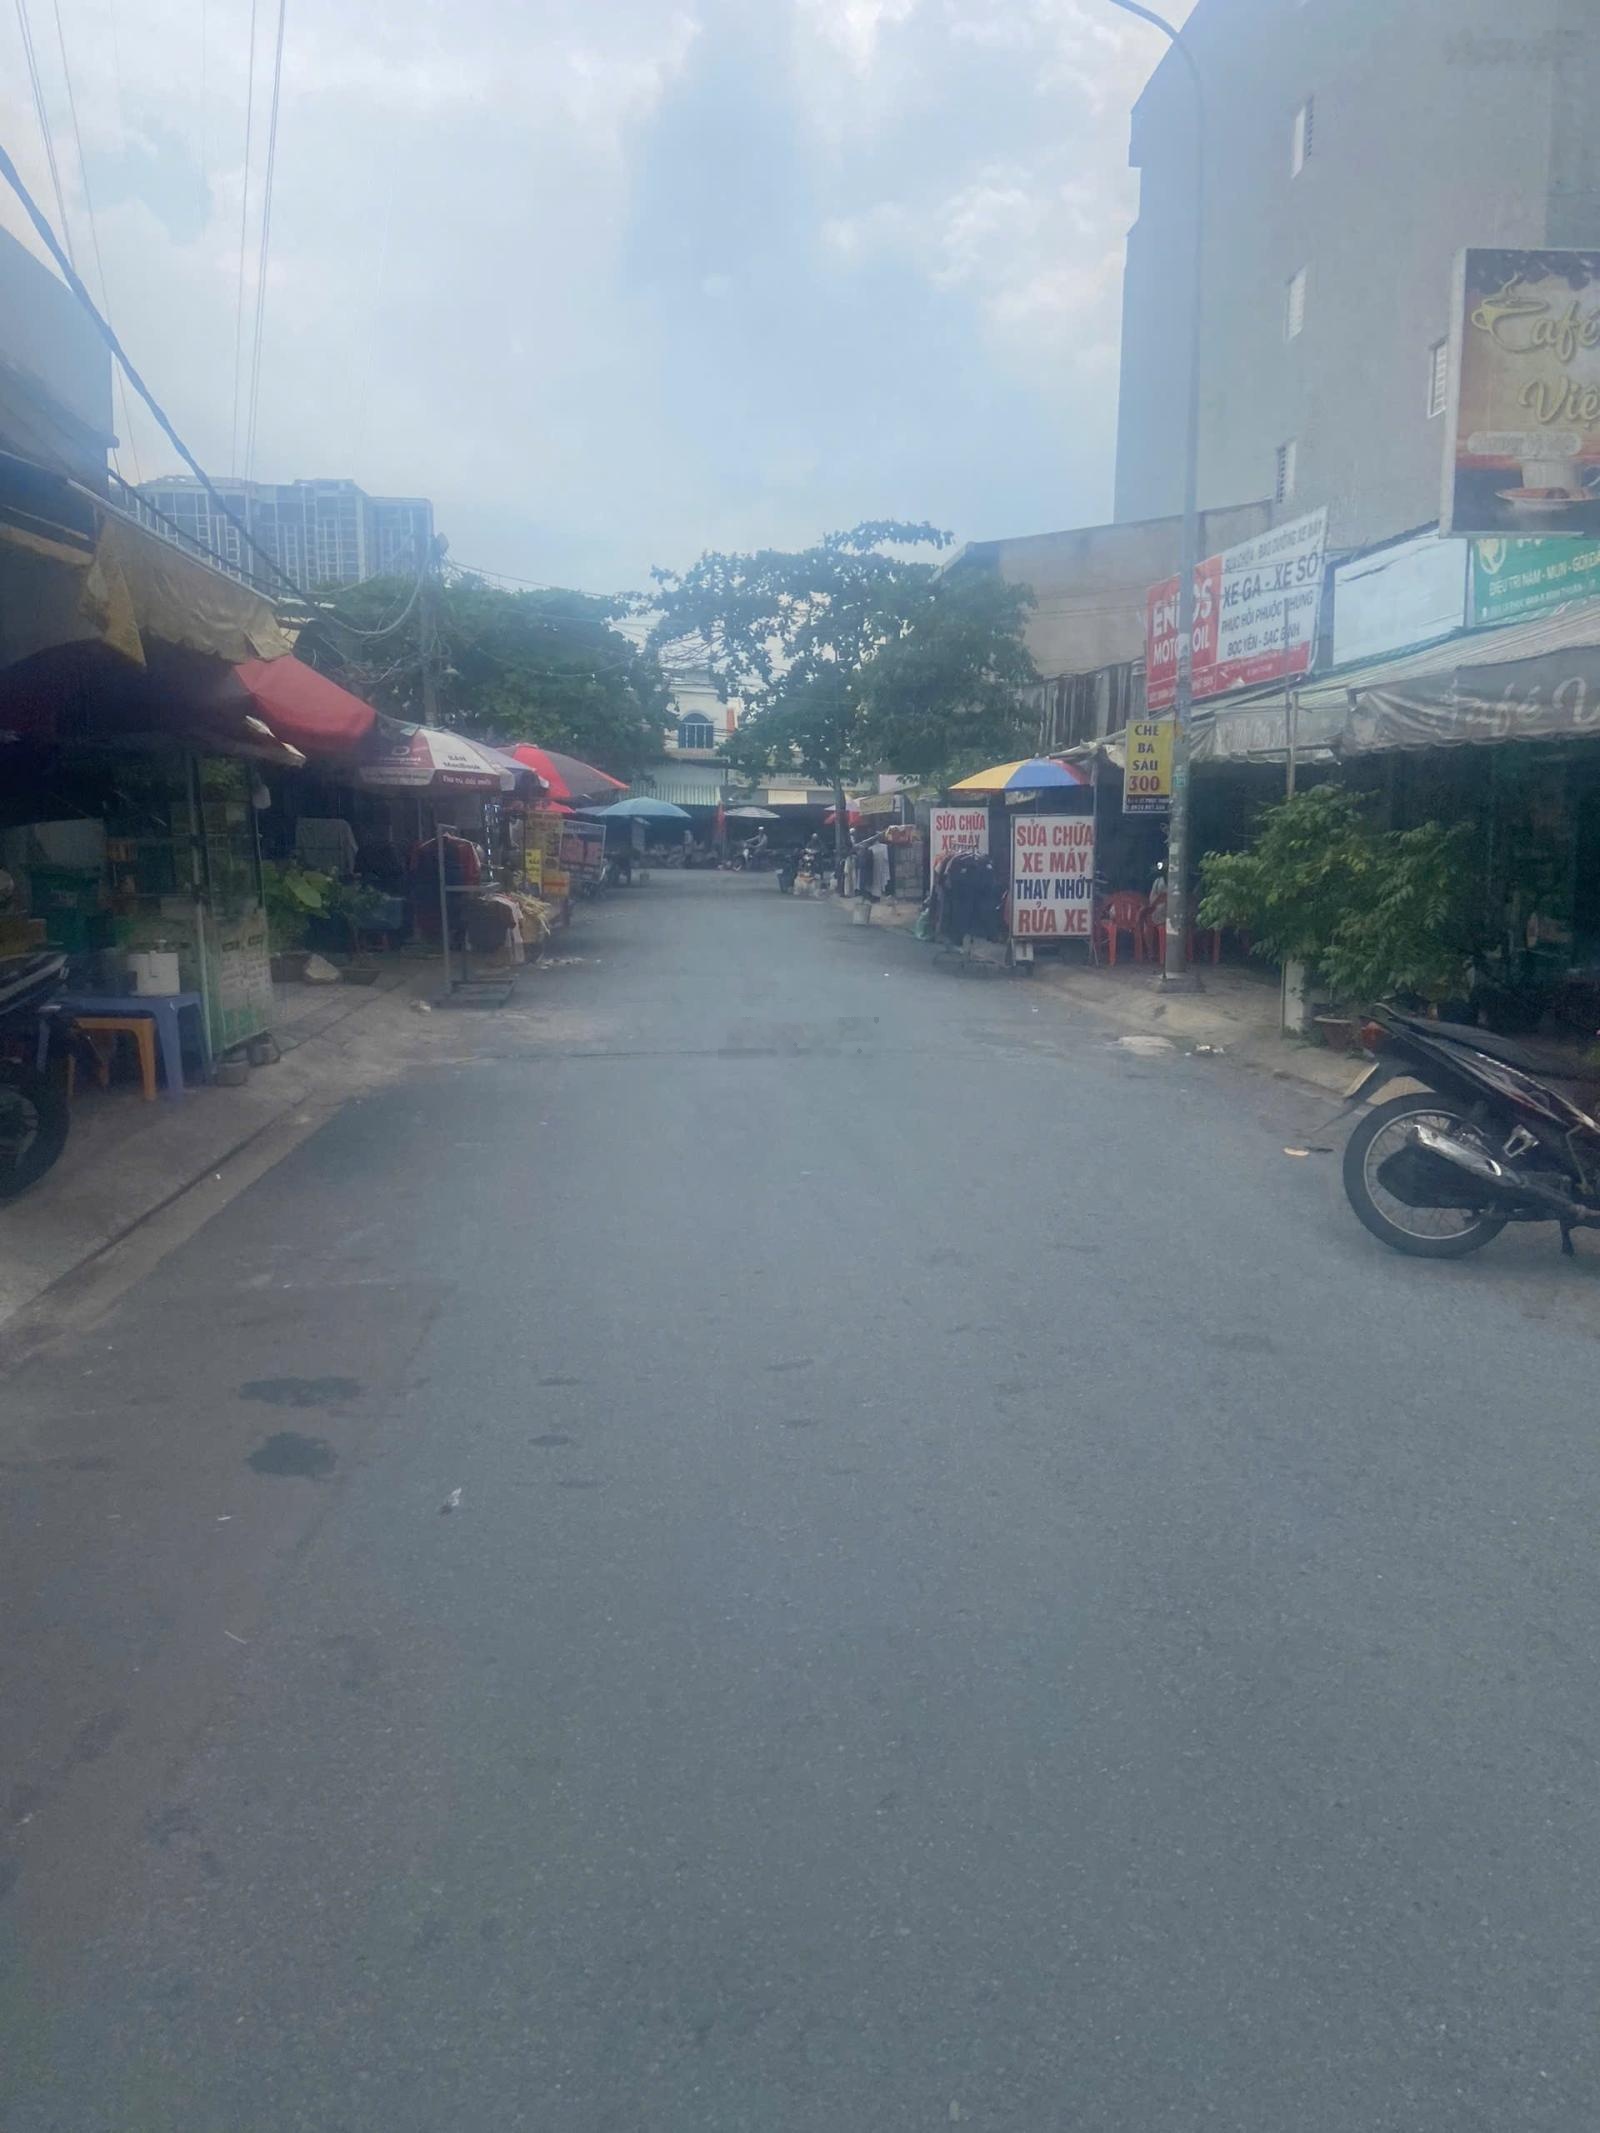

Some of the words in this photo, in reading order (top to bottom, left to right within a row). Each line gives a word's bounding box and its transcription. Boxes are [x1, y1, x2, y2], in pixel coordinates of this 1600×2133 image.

[1223, 582, 1240, 609] XE
[1242, 574, 1260, 602] GA
[1274, 561, 1294, 591] XE
[1296, 541, 1320, 583] SỐ
[1192, 624, 1209, 653] OIL
[1128, 775, 1161, 792] 300
[936, 810, 957, 831] SỬA
[959, 811, 986, 831] CHỮA
[1016, 819, 1048, 847] SỬA
[1052, 821, 1094, 847] CHỮA
[1022, 852, 1044, 873] XE
[1049, 847, 1088, 873] MÁY
[1016, 879, 1051, 900] THAY
[1055, 874, 1093, 900] NHỚT
[1018, 900, 1058, 933] RỬA
[1064, 908, 1088, 933] XE
